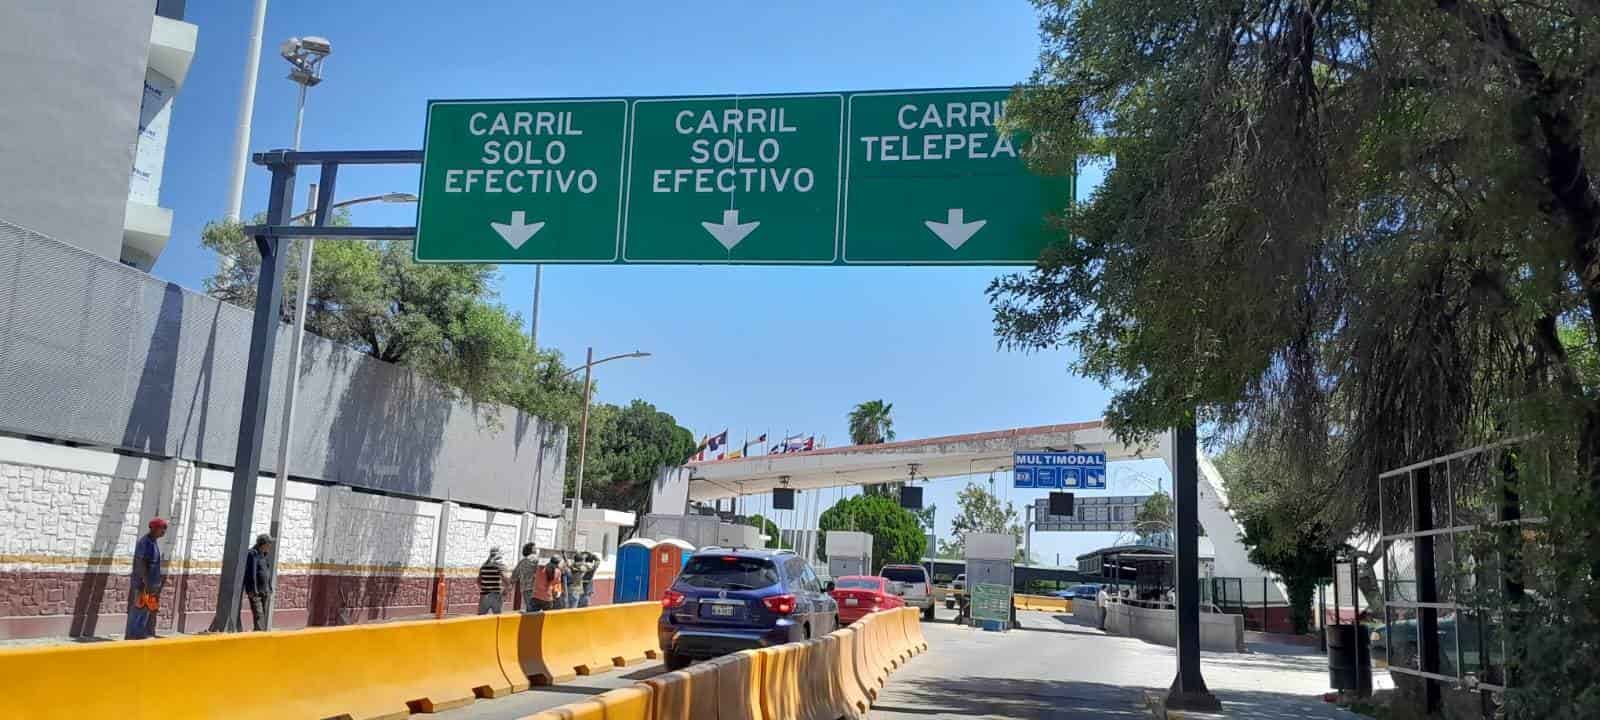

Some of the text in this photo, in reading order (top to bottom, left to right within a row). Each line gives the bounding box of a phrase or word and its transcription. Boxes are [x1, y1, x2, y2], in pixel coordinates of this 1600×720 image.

[469, 111, 583, 136] CARRIL
[675, 109, 797, 134] CARRIL
[482, 141, 566, 165] SOLO
[691, 139, 780, 164] SOLO
[445, 170, 598, 193] EFECTIVO
[653, 168, 814, 192] EFECTIVO
[1016, 455, 1103, 465] MULTIMODAL
